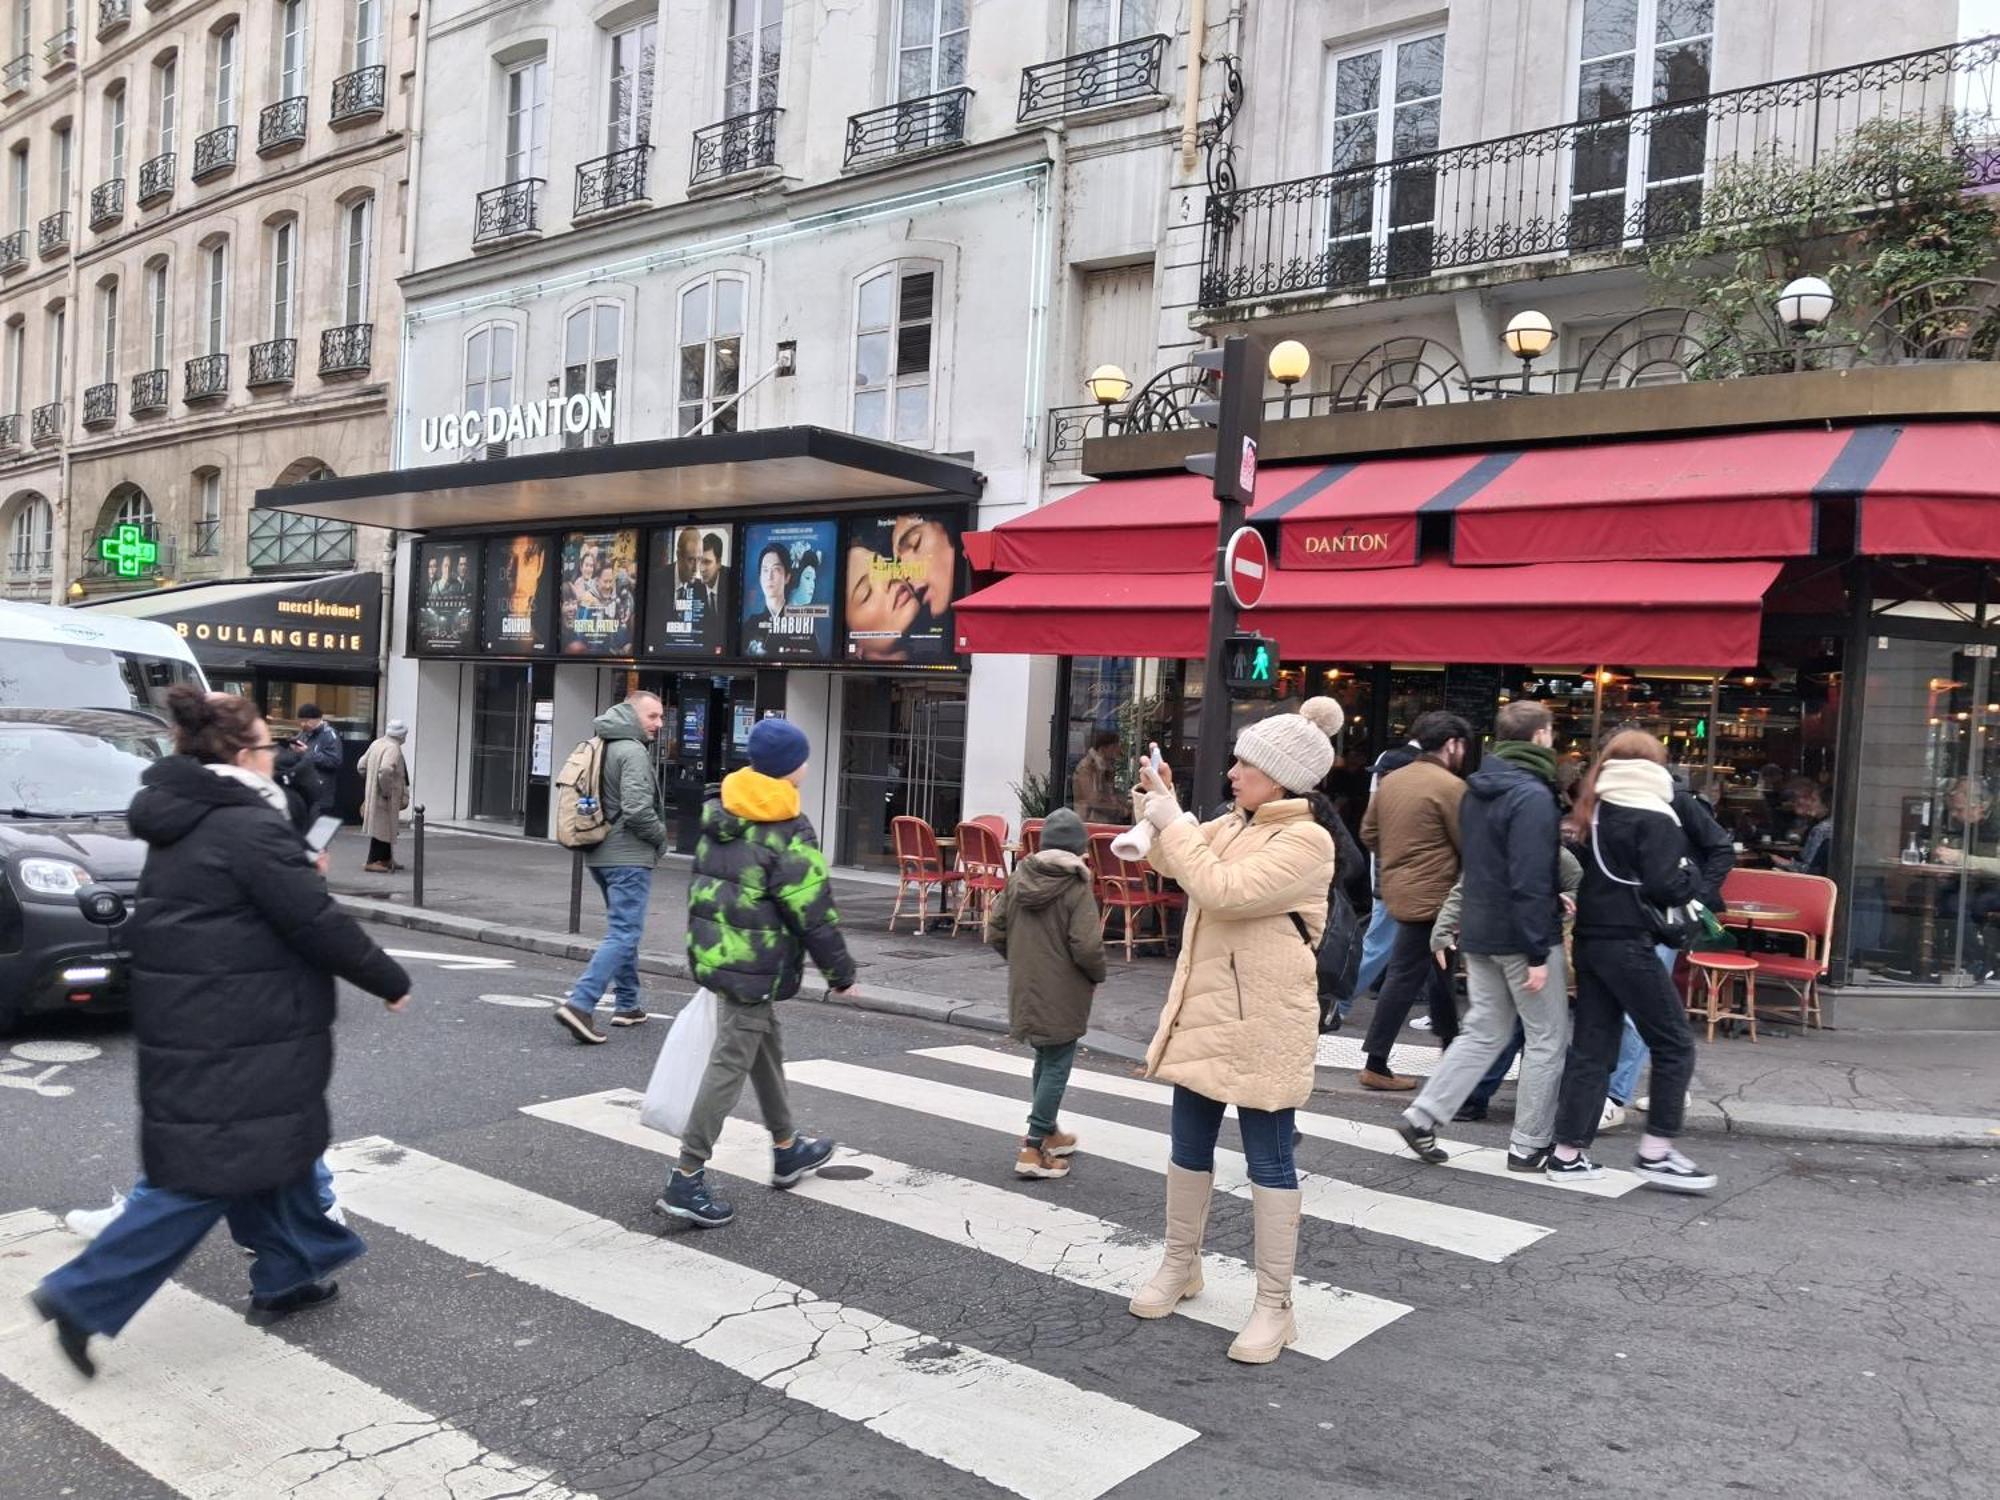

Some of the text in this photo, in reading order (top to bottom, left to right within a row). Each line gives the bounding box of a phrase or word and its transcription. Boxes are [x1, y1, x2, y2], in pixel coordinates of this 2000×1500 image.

[420, 389, 613, 453] UGC DANTON
[1305, 533, 1390, 553] DANTON
[278, 598, 361, 620] merci jérôme!
[772, 616, 814, 634] KABUKI
